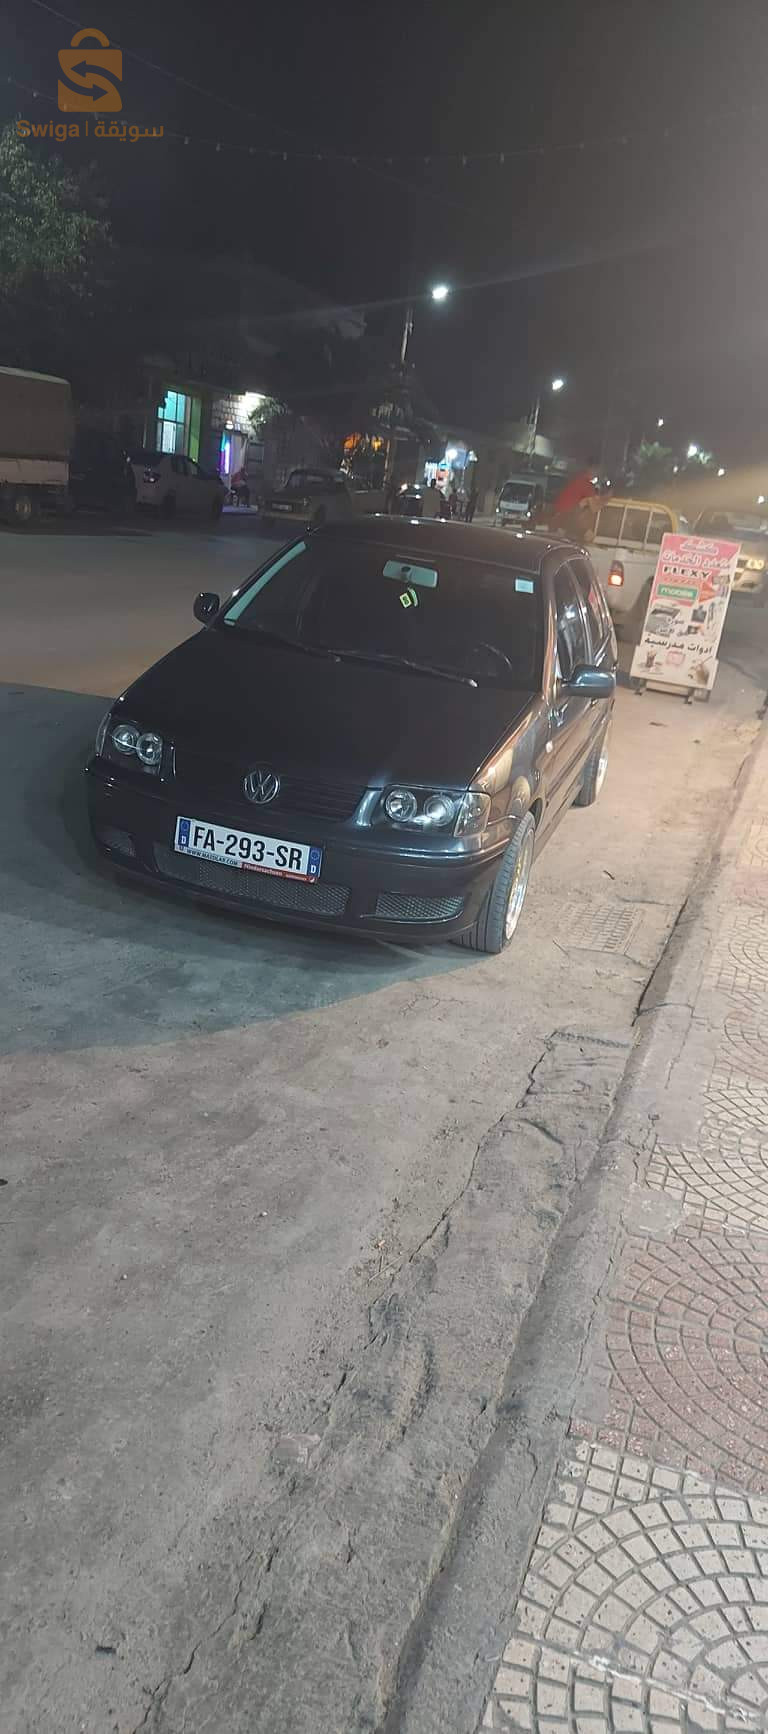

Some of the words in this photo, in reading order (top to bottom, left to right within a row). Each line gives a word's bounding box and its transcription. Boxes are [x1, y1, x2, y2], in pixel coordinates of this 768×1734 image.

[663, 565, 712, 580] FLEXY
[644, 633, 685, 651] مدرسية
[181, 835, 187, 845] D
[193, 825, 303, 871] FA-293-SR
[310, 865, 317, 874] D
